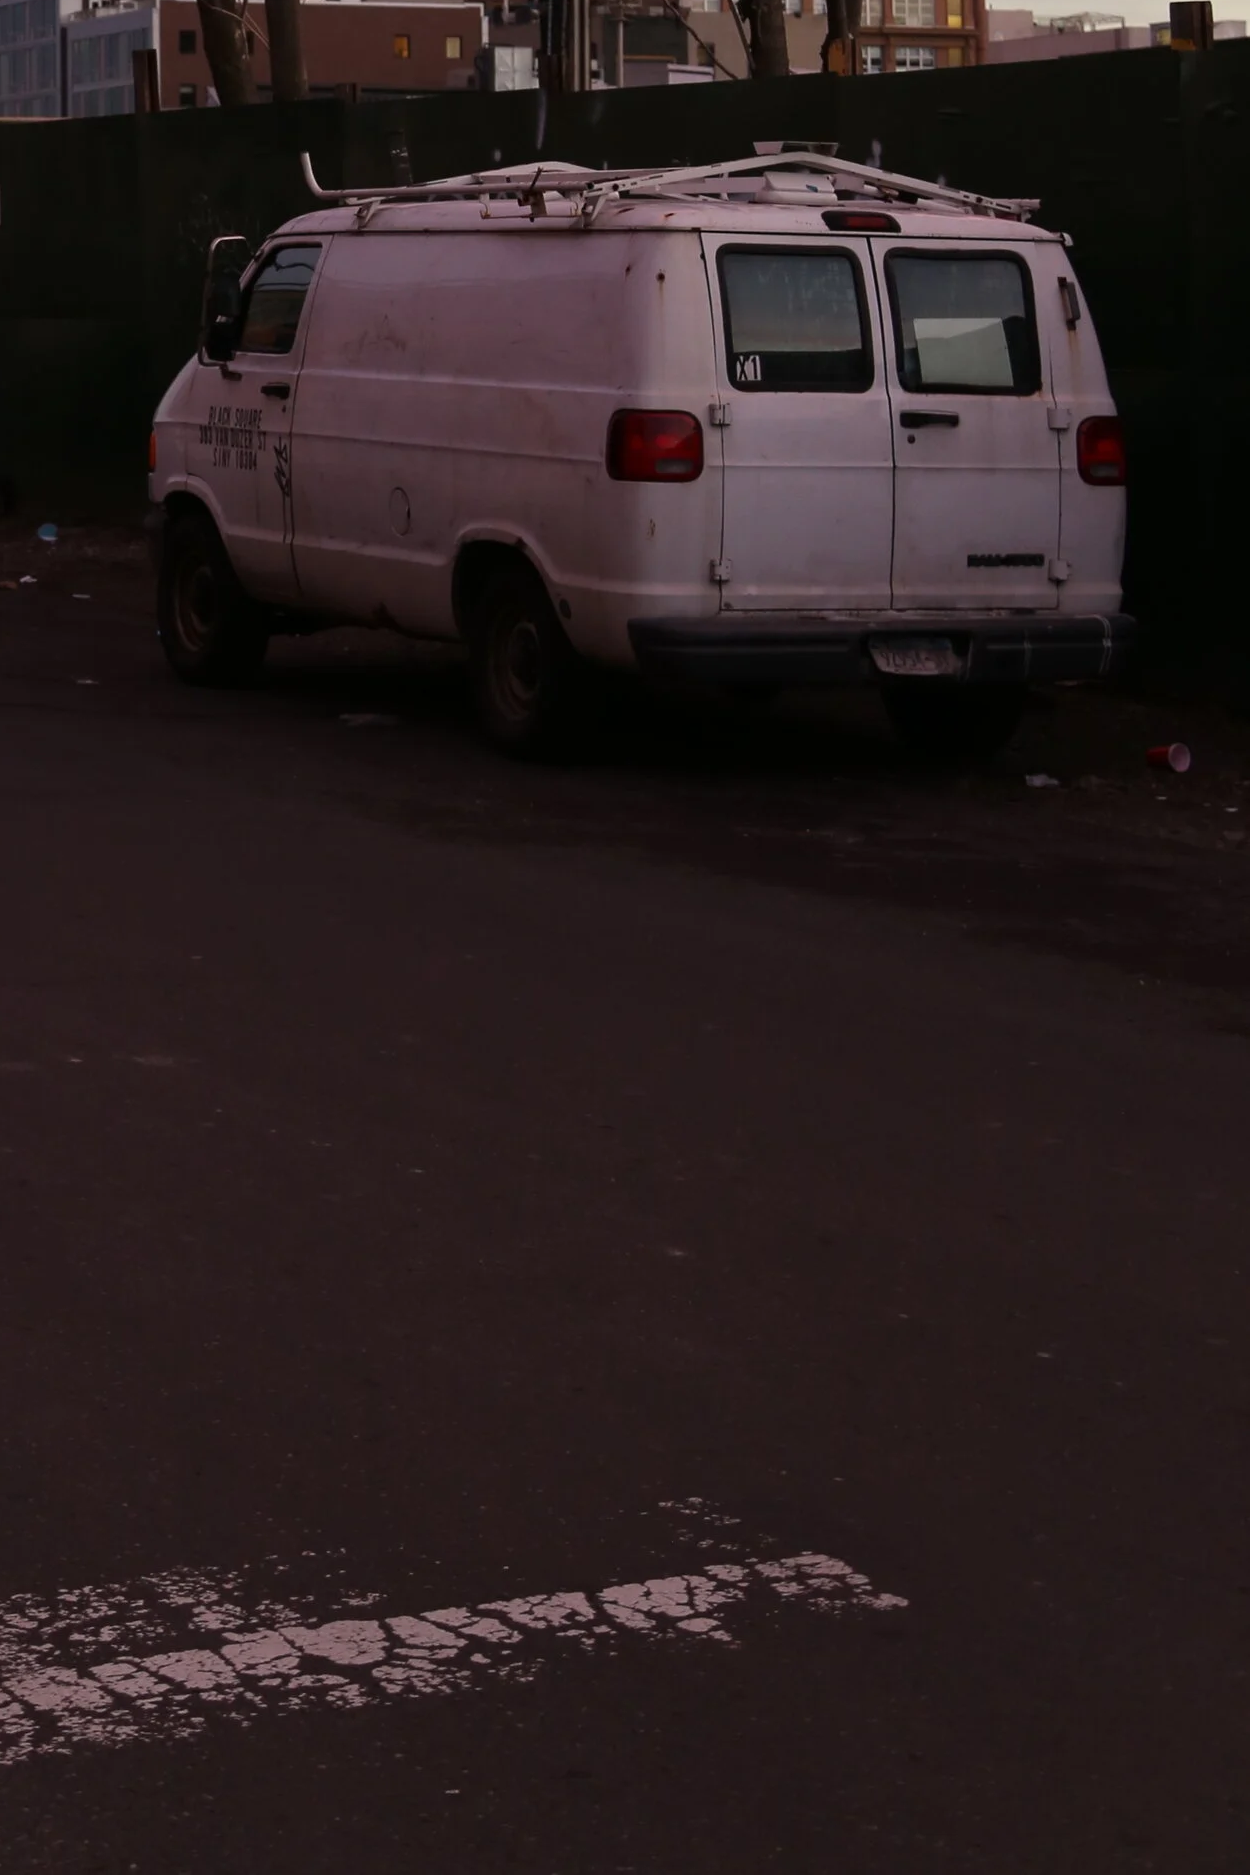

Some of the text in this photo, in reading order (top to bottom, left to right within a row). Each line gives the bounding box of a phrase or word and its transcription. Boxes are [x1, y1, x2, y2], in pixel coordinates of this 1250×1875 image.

[208, 405, 263, 429] BLACK SQUARE
[215, 426, 229, 447] VAN
